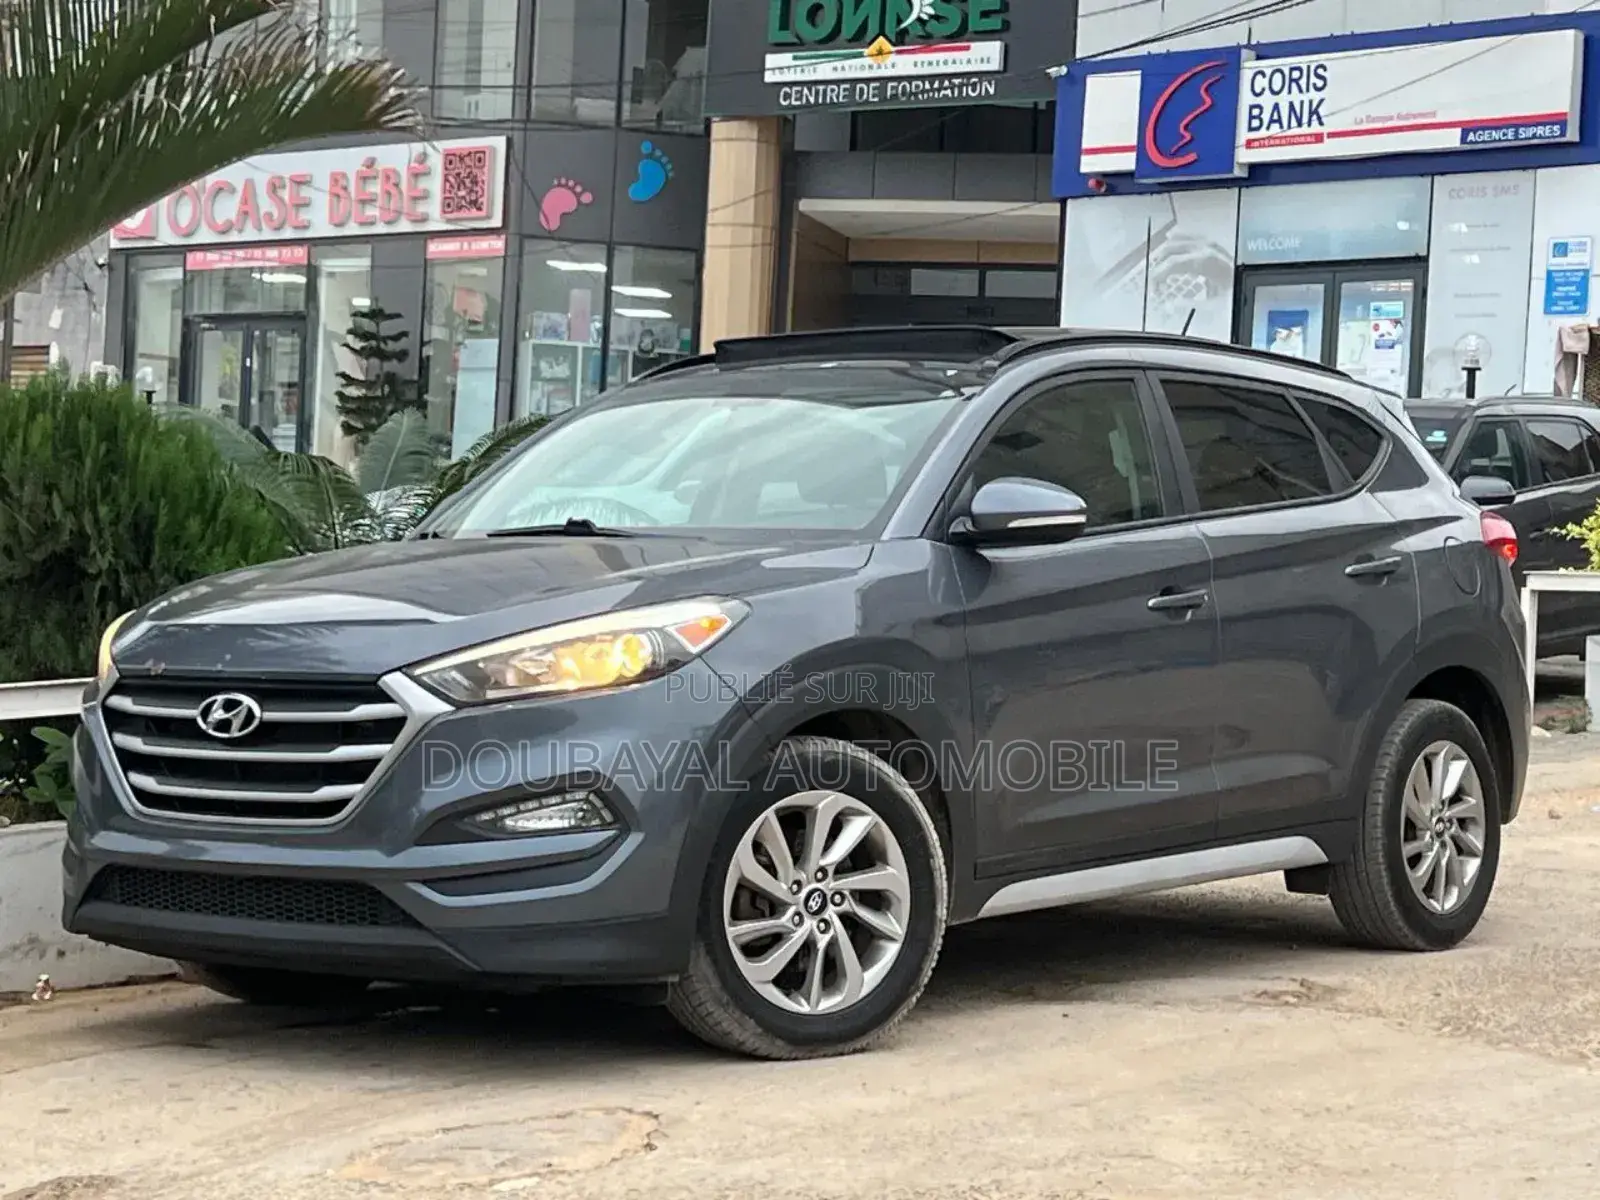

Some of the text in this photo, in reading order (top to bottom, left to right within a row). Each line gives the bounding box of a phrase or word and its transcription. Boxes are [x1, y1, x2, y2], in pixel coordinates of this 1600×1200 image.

[779, 78, 995, 105] CENTRE DE FORMATION
[1250, 64, 1328, 97] CORIS
[1248, 98, 1325, 132] BANK
[1467, 124, 1561, 142] AGENCE SIPRES
[328, 152, 431, 227] BÉBÉ
[1448, 186, 1488, 200] CORIS
[1247, 234, 1301, 251] WELCOME
